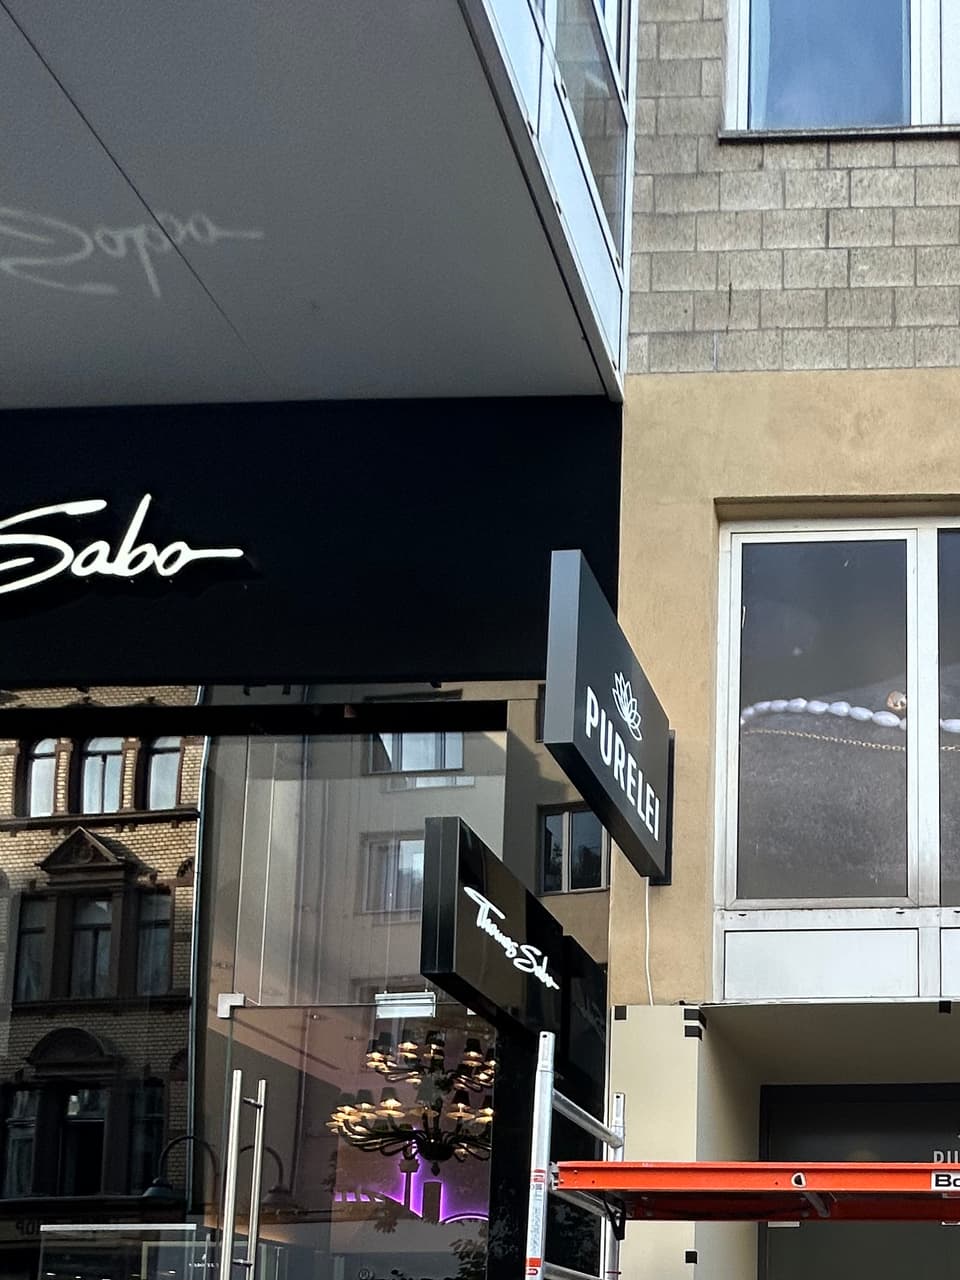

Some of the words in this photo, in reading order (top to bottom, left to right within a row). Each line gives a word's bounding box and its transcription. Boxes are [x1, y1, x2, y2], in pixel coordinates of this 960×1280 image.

[0, 493, 244, 593] Sabo
[585, 686, 660, 841] PURELEI
[463, 886, 519, 959] Thomas
